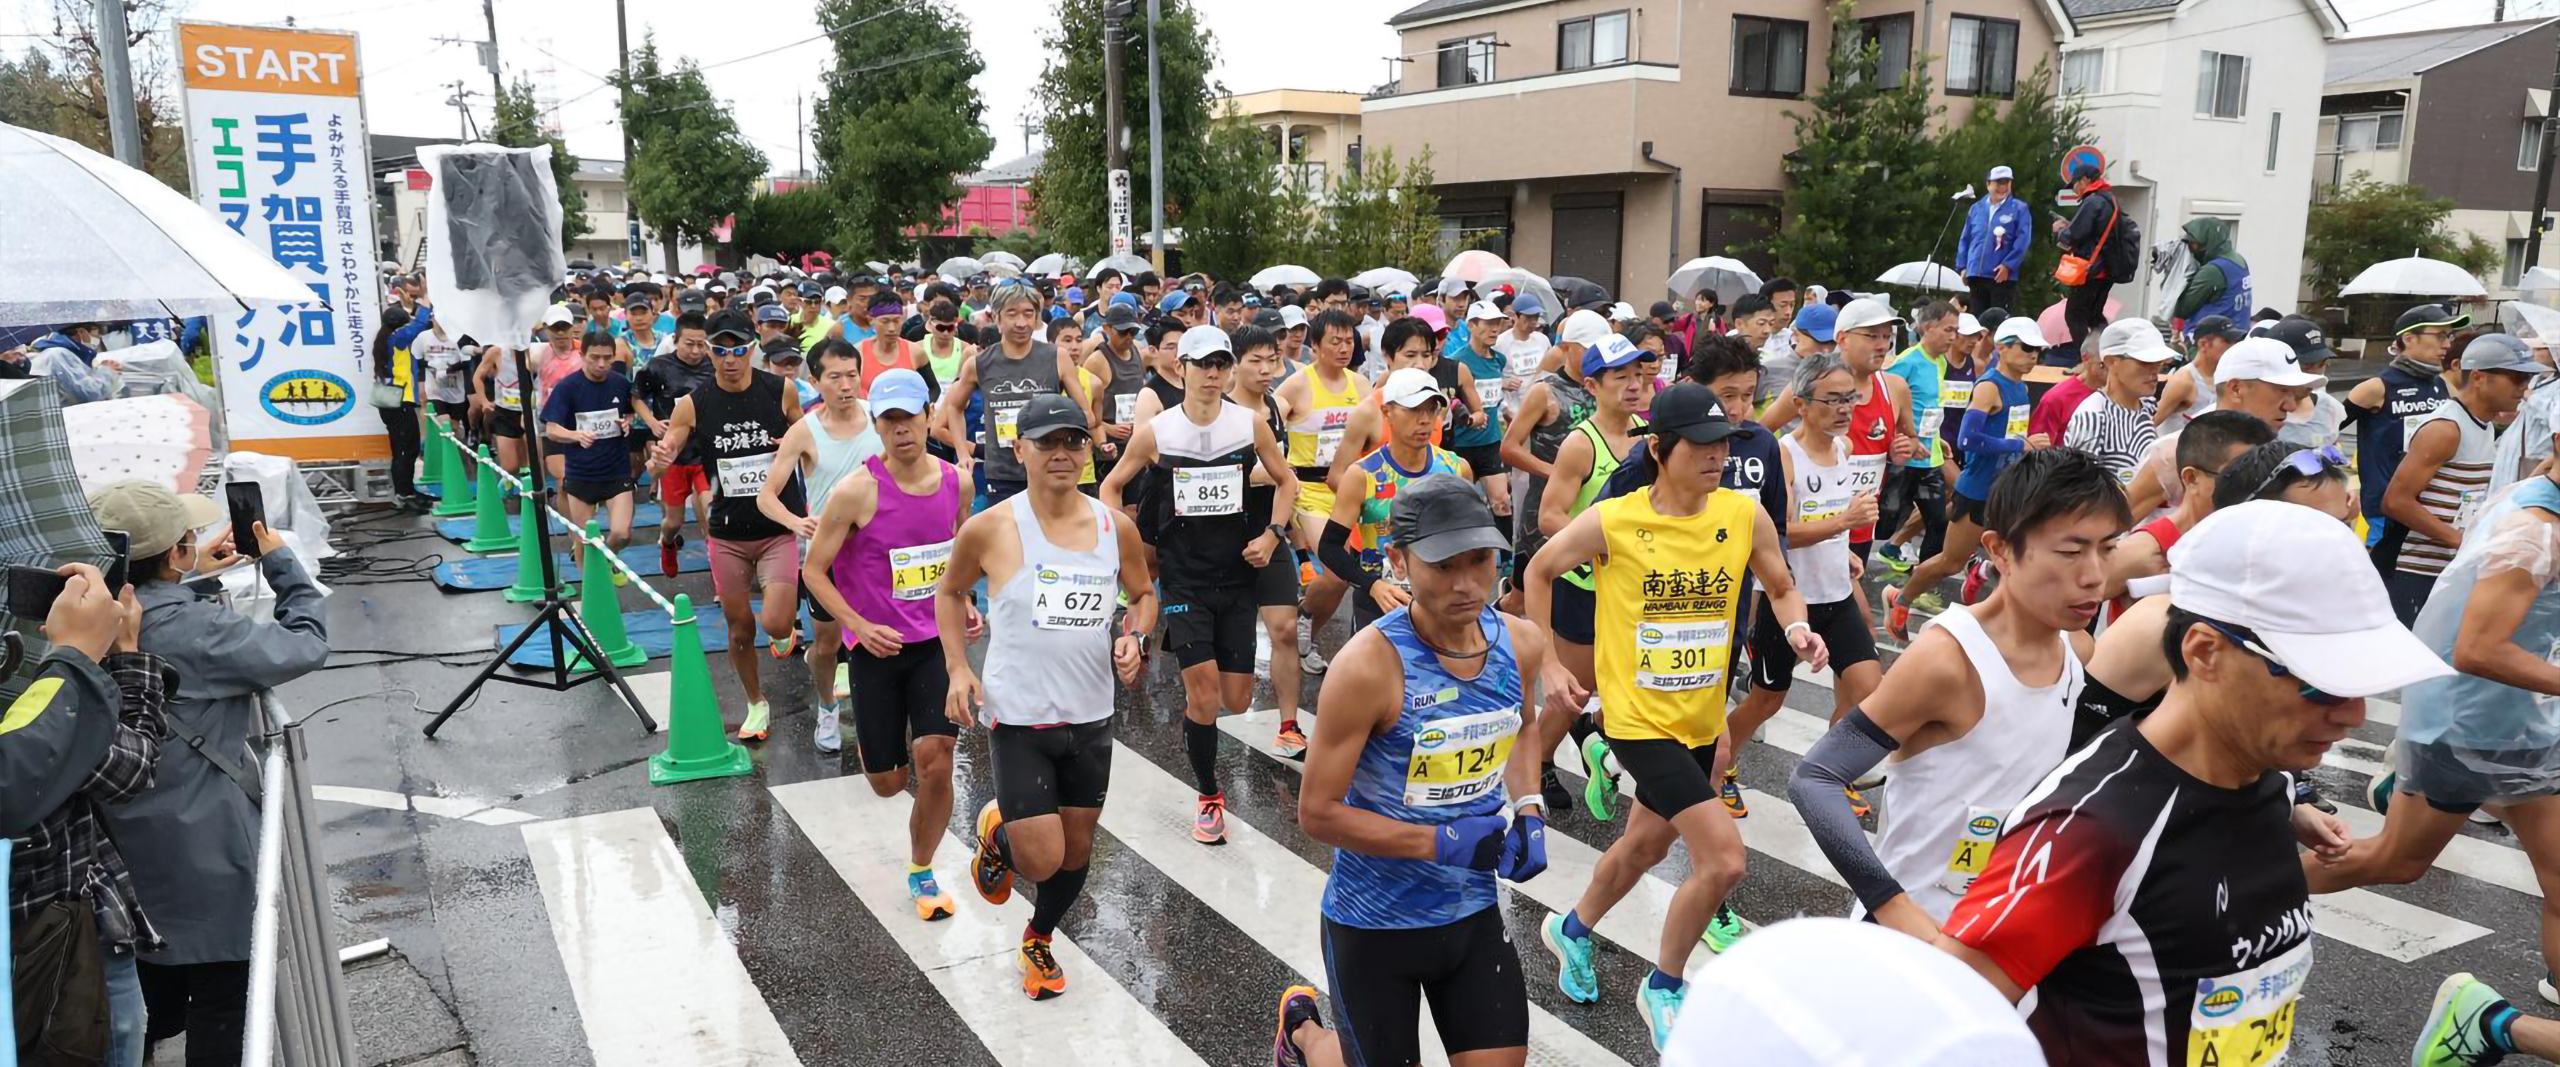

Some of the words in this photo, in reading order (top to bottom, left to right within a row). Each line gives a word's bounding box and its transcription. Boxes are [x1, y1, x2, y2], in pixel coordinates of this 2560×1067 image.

[196, 45, 346, 84] START
[327, 114, 354, 235] よみがえる手賀沼
[255, 112, 336, 347] 手賀沼
[211, 118, 265, 372] エコマン
[592, 420, 612, 431] 369
[722, 477, 730, 485] A
[739, 470, 767, 484] 626
[1851, 471, 1877, 485] 762
[1177, 490, 1186, 500] A
[1198, 485, 1229, 500] 845
[919, 562, 946, 582] 136
[1643, 566, 1734, 597] 南蛮連合
[1036, 593, 1048, 607] A
[1064, 592, 1103, 611] 672
[1643, 601, 1689, 612] NAMBAN
[1692, 600, 1727, 610] RENGO
[1640, 654, 1652, 669] A
[1670, 648, 1706, 669] 301
[1454, 742, 1497, 776] 124
[1413, 761, 1429, 778] A
[1955, 847, 1973, 867] A
